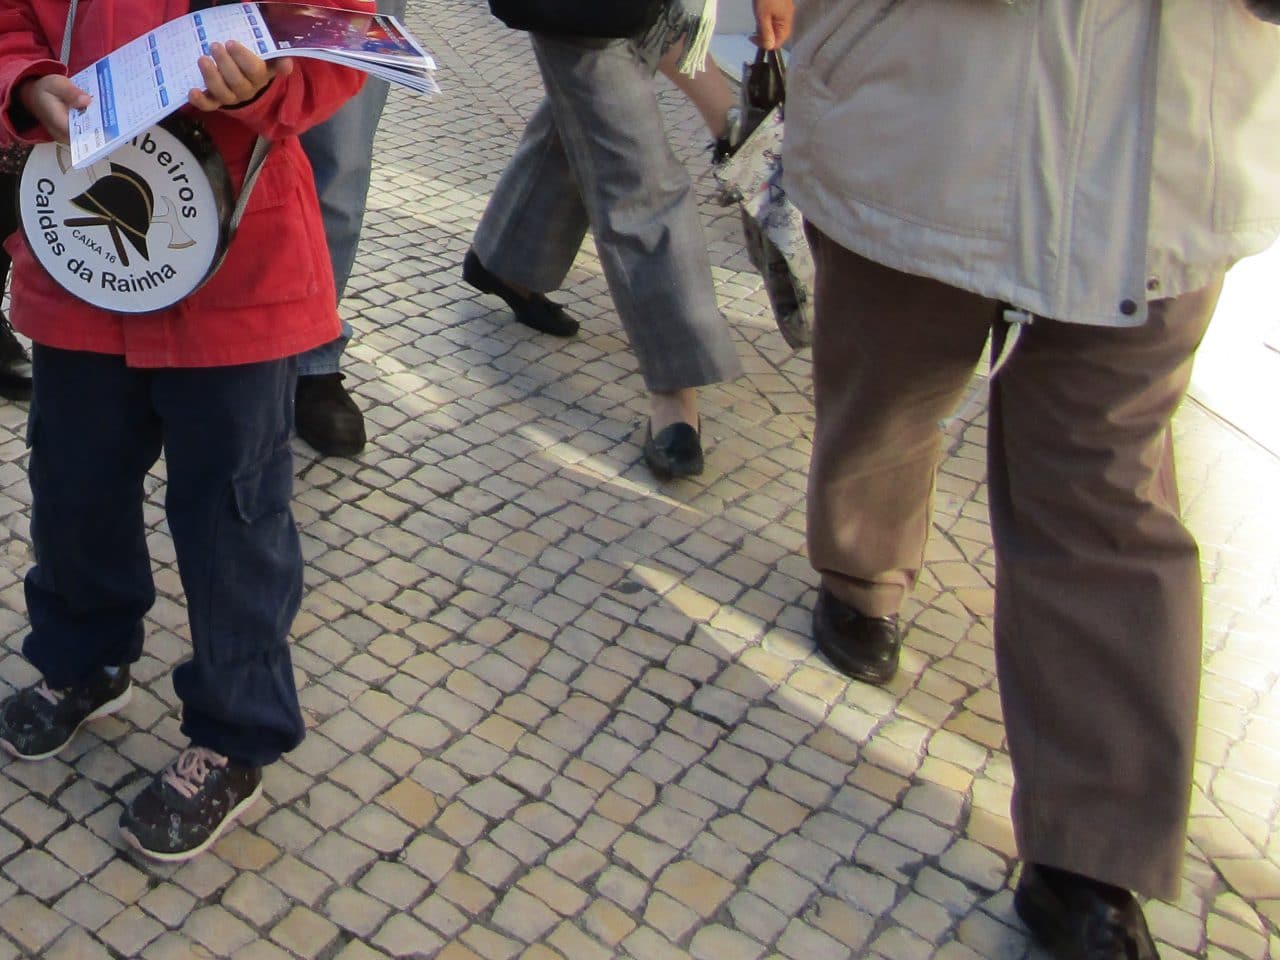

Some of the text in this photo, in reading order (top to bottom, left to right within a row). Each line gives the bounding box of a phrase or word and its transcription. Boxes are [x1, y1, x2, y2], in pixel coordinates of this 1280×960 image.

[35, 178, 177, 293] Caldas da Rainha
[72, 229, 117, 264] CAIXA 16
